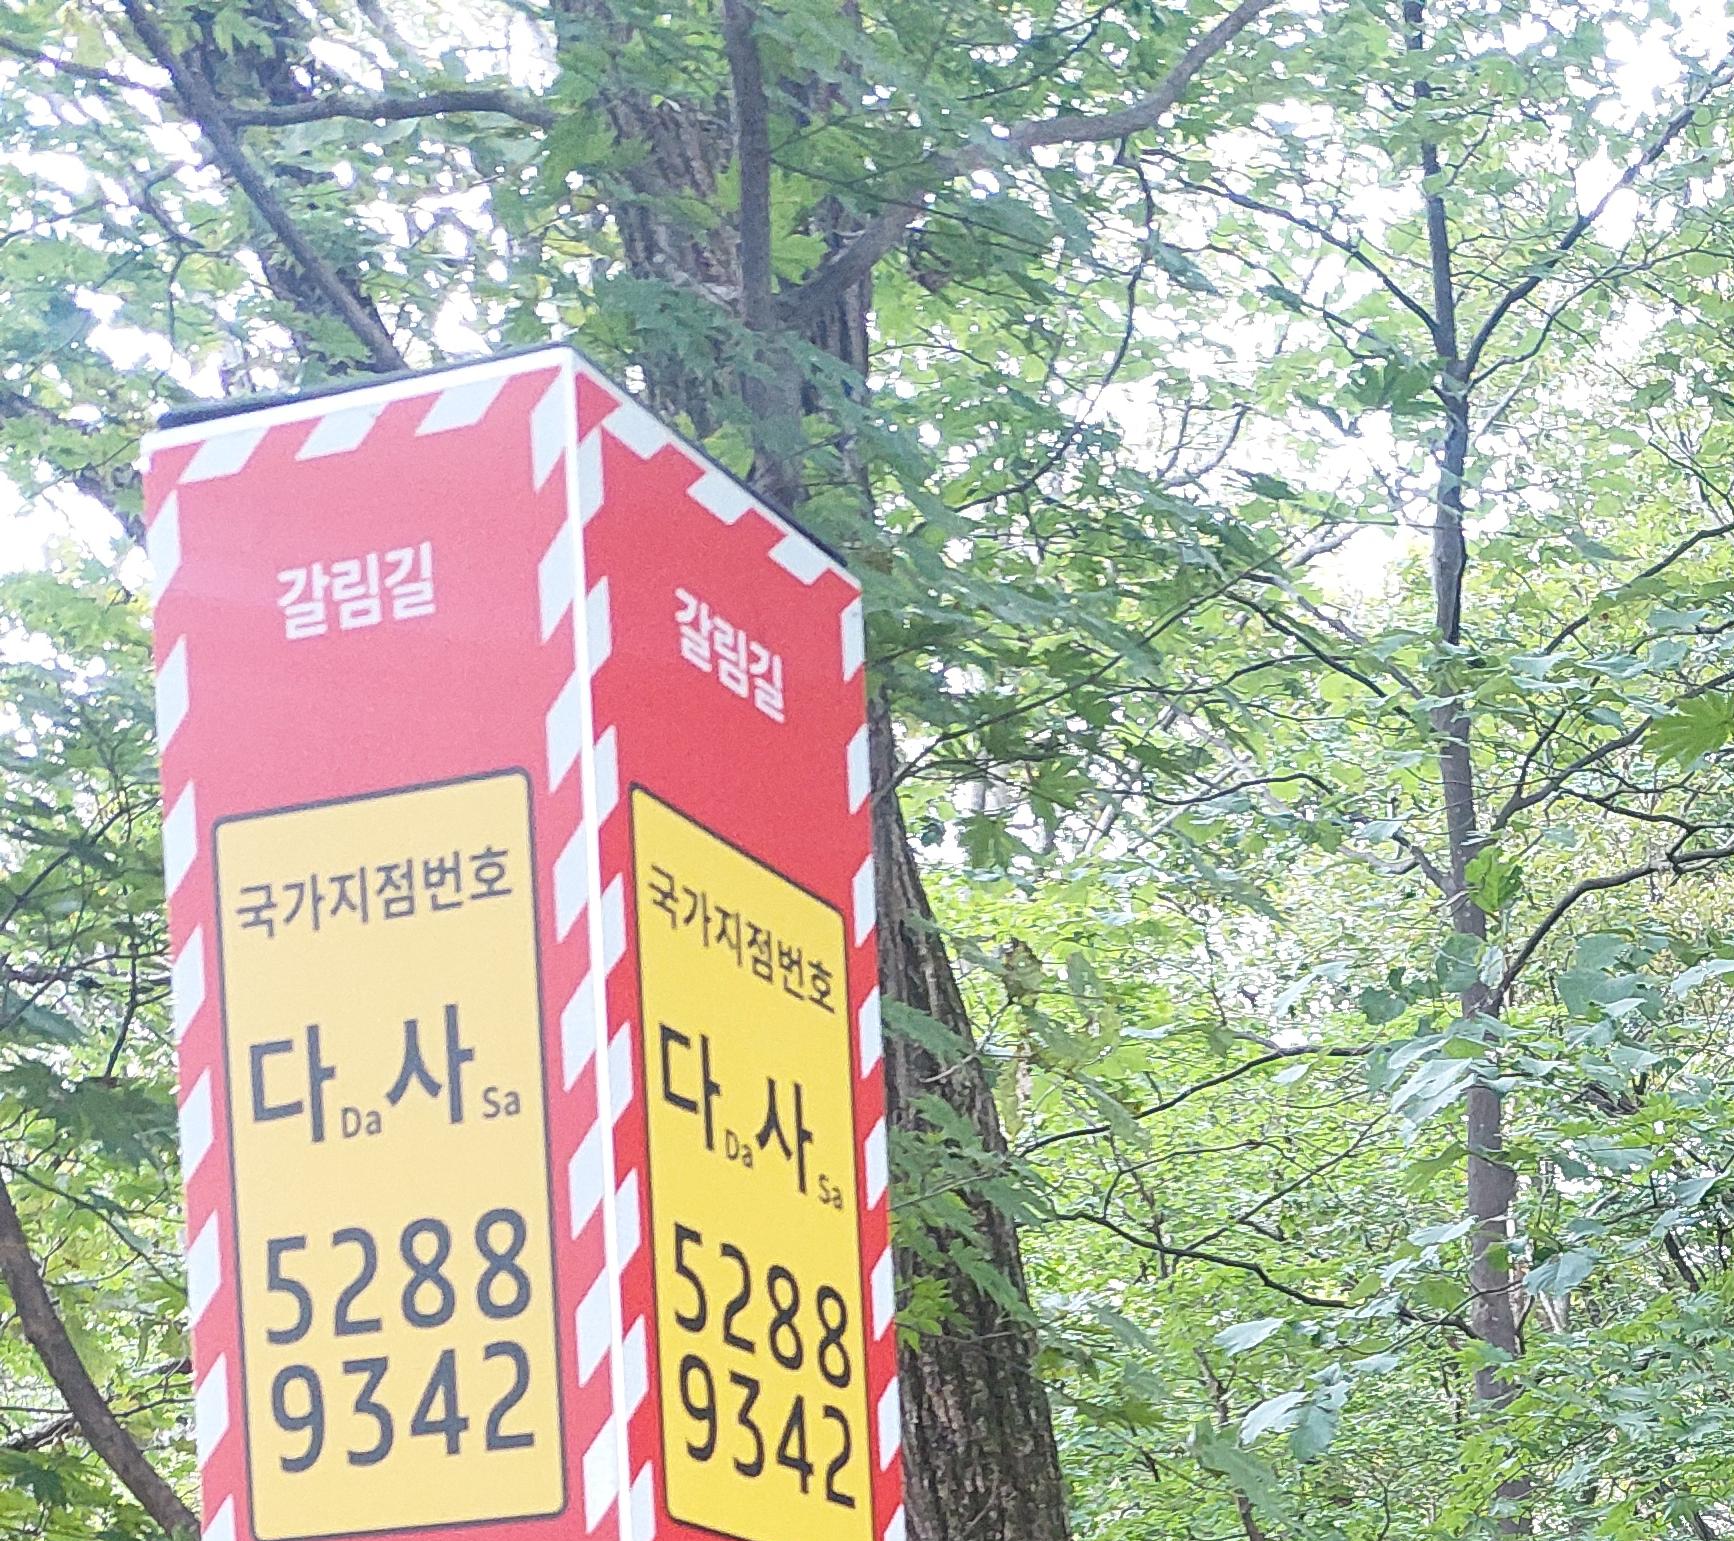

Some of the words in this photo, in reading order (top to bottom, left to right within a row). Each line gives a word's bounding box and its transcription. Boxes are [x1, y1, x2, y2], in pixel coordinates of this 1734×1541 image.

[277, 541, 436, 640] 갈림길
[674, 588, 787, 723] 갈림길
[236, 845, 513, 939] 국가지점번호
[648, 865, 836, 1014] 국가지점번호
[265, 1207, 533, 1345] 5288
[674, 1222, 852, 1389] 5288
[271, 1340, 535, 1474] 9342
[679, 1354, 857, 1509] 9342
